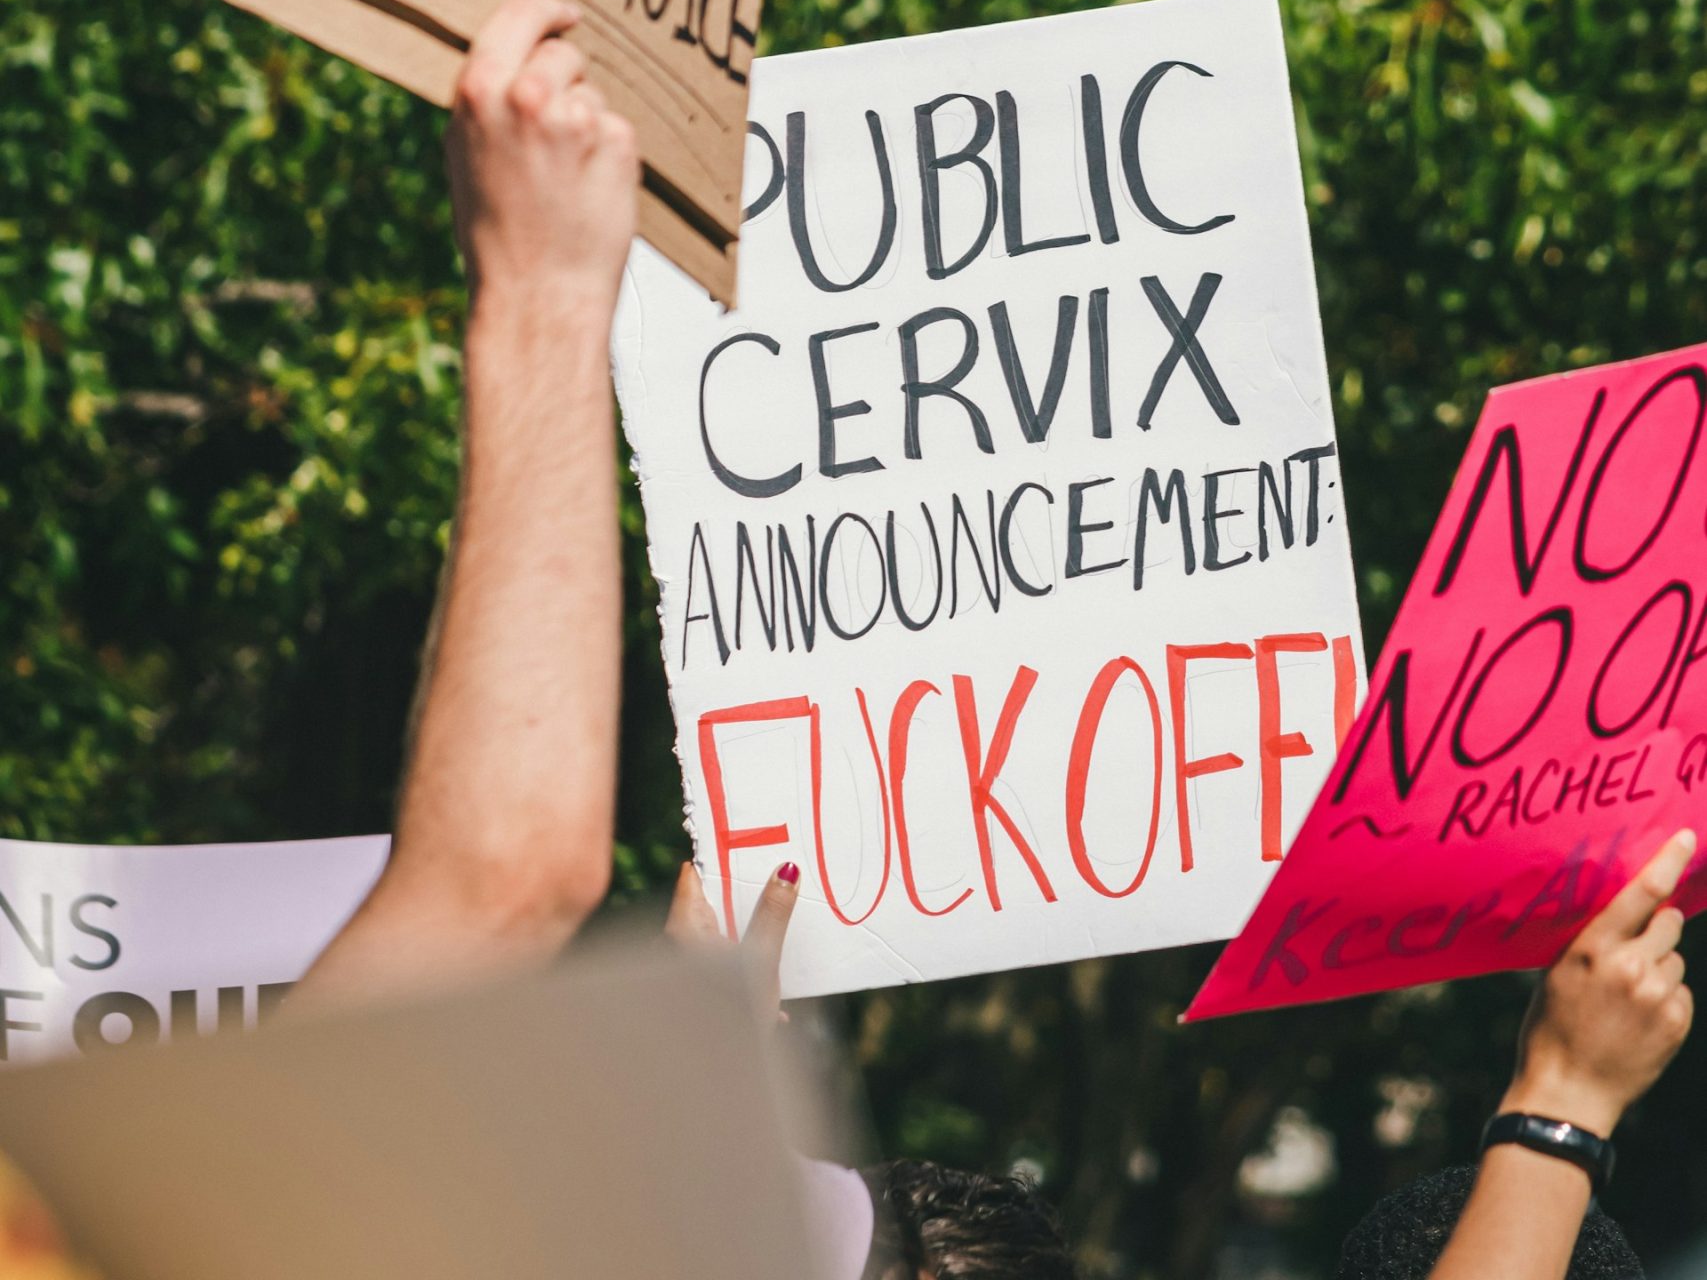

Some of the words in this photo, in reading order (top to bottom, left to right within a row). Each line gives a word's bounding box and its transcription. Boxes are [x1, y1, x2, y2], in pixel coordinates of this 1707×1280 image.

[699, 271, 1241, 498] CERVIX
[1432, 363, 1707, 597] NO
[681, 441, 1337, 670] ANNOUNCEMENT:
[697, 664, 1059, 943] FUCK
[1330, 605, 1574, 804] NO
[1438, 743, 1656, 843] RACHEL
